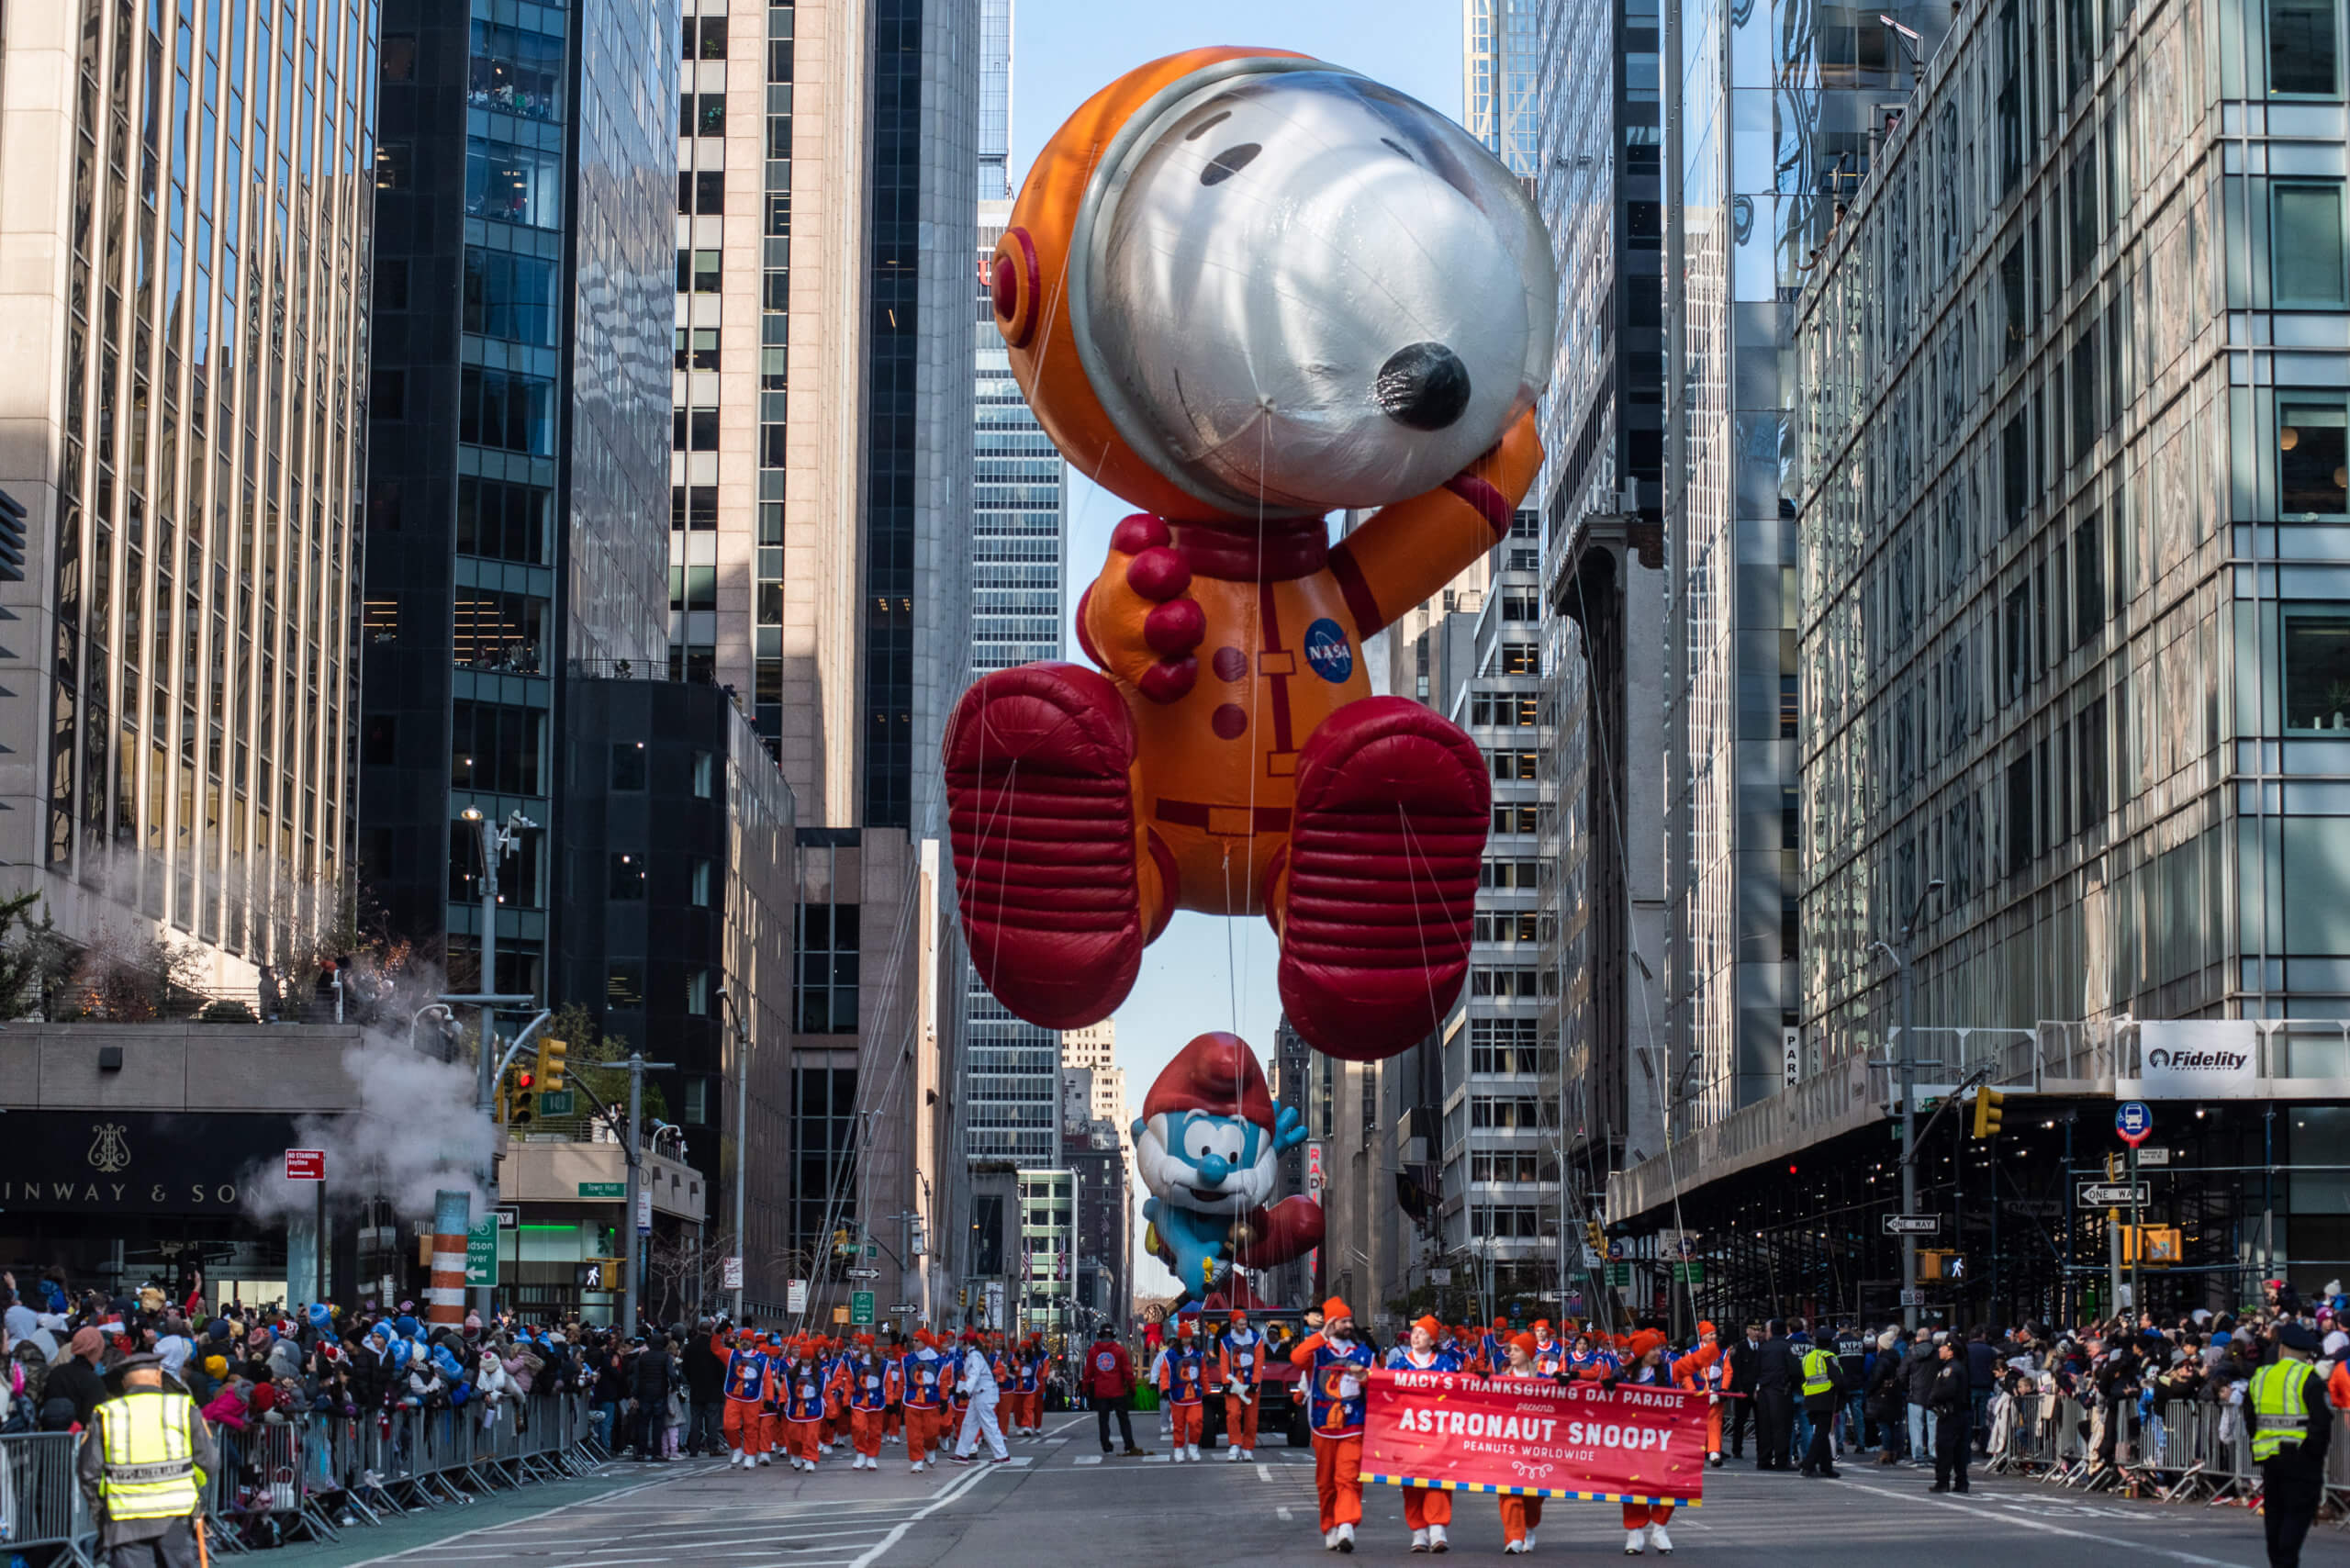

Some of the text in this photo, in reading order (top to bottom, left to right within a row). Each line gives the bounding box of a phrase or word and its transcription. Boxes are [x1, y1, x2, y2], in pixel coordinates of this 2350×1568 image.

[1309, 644, 1350, 660] NASA
[1786, 1036, 1796, 1086] PARK
[2171, 1050, 2247, 1070] Fidelity
[1310, 1148, 1320, 1204] RADI
[5, 1182, 126, 1202] INWAY
[151, 1184, 166, 1202] &
[2088, 1190, 2109, 1199] ONE
[1892, 1219, 1932, 1228] ONE WAY
[1840, 1341, 1863, 1350] NYPD
[1394, 1372, 1684, 1408] MACY'S THANKSGIVING DAY PARADE
[1515, 1402, 1556, 1414] presents
[1398, 1407, 1673, 1451] ASTRONAUT SNOOPY
[1463, 1440, 1595, 1462] PEANUTS WORLDWIDE
